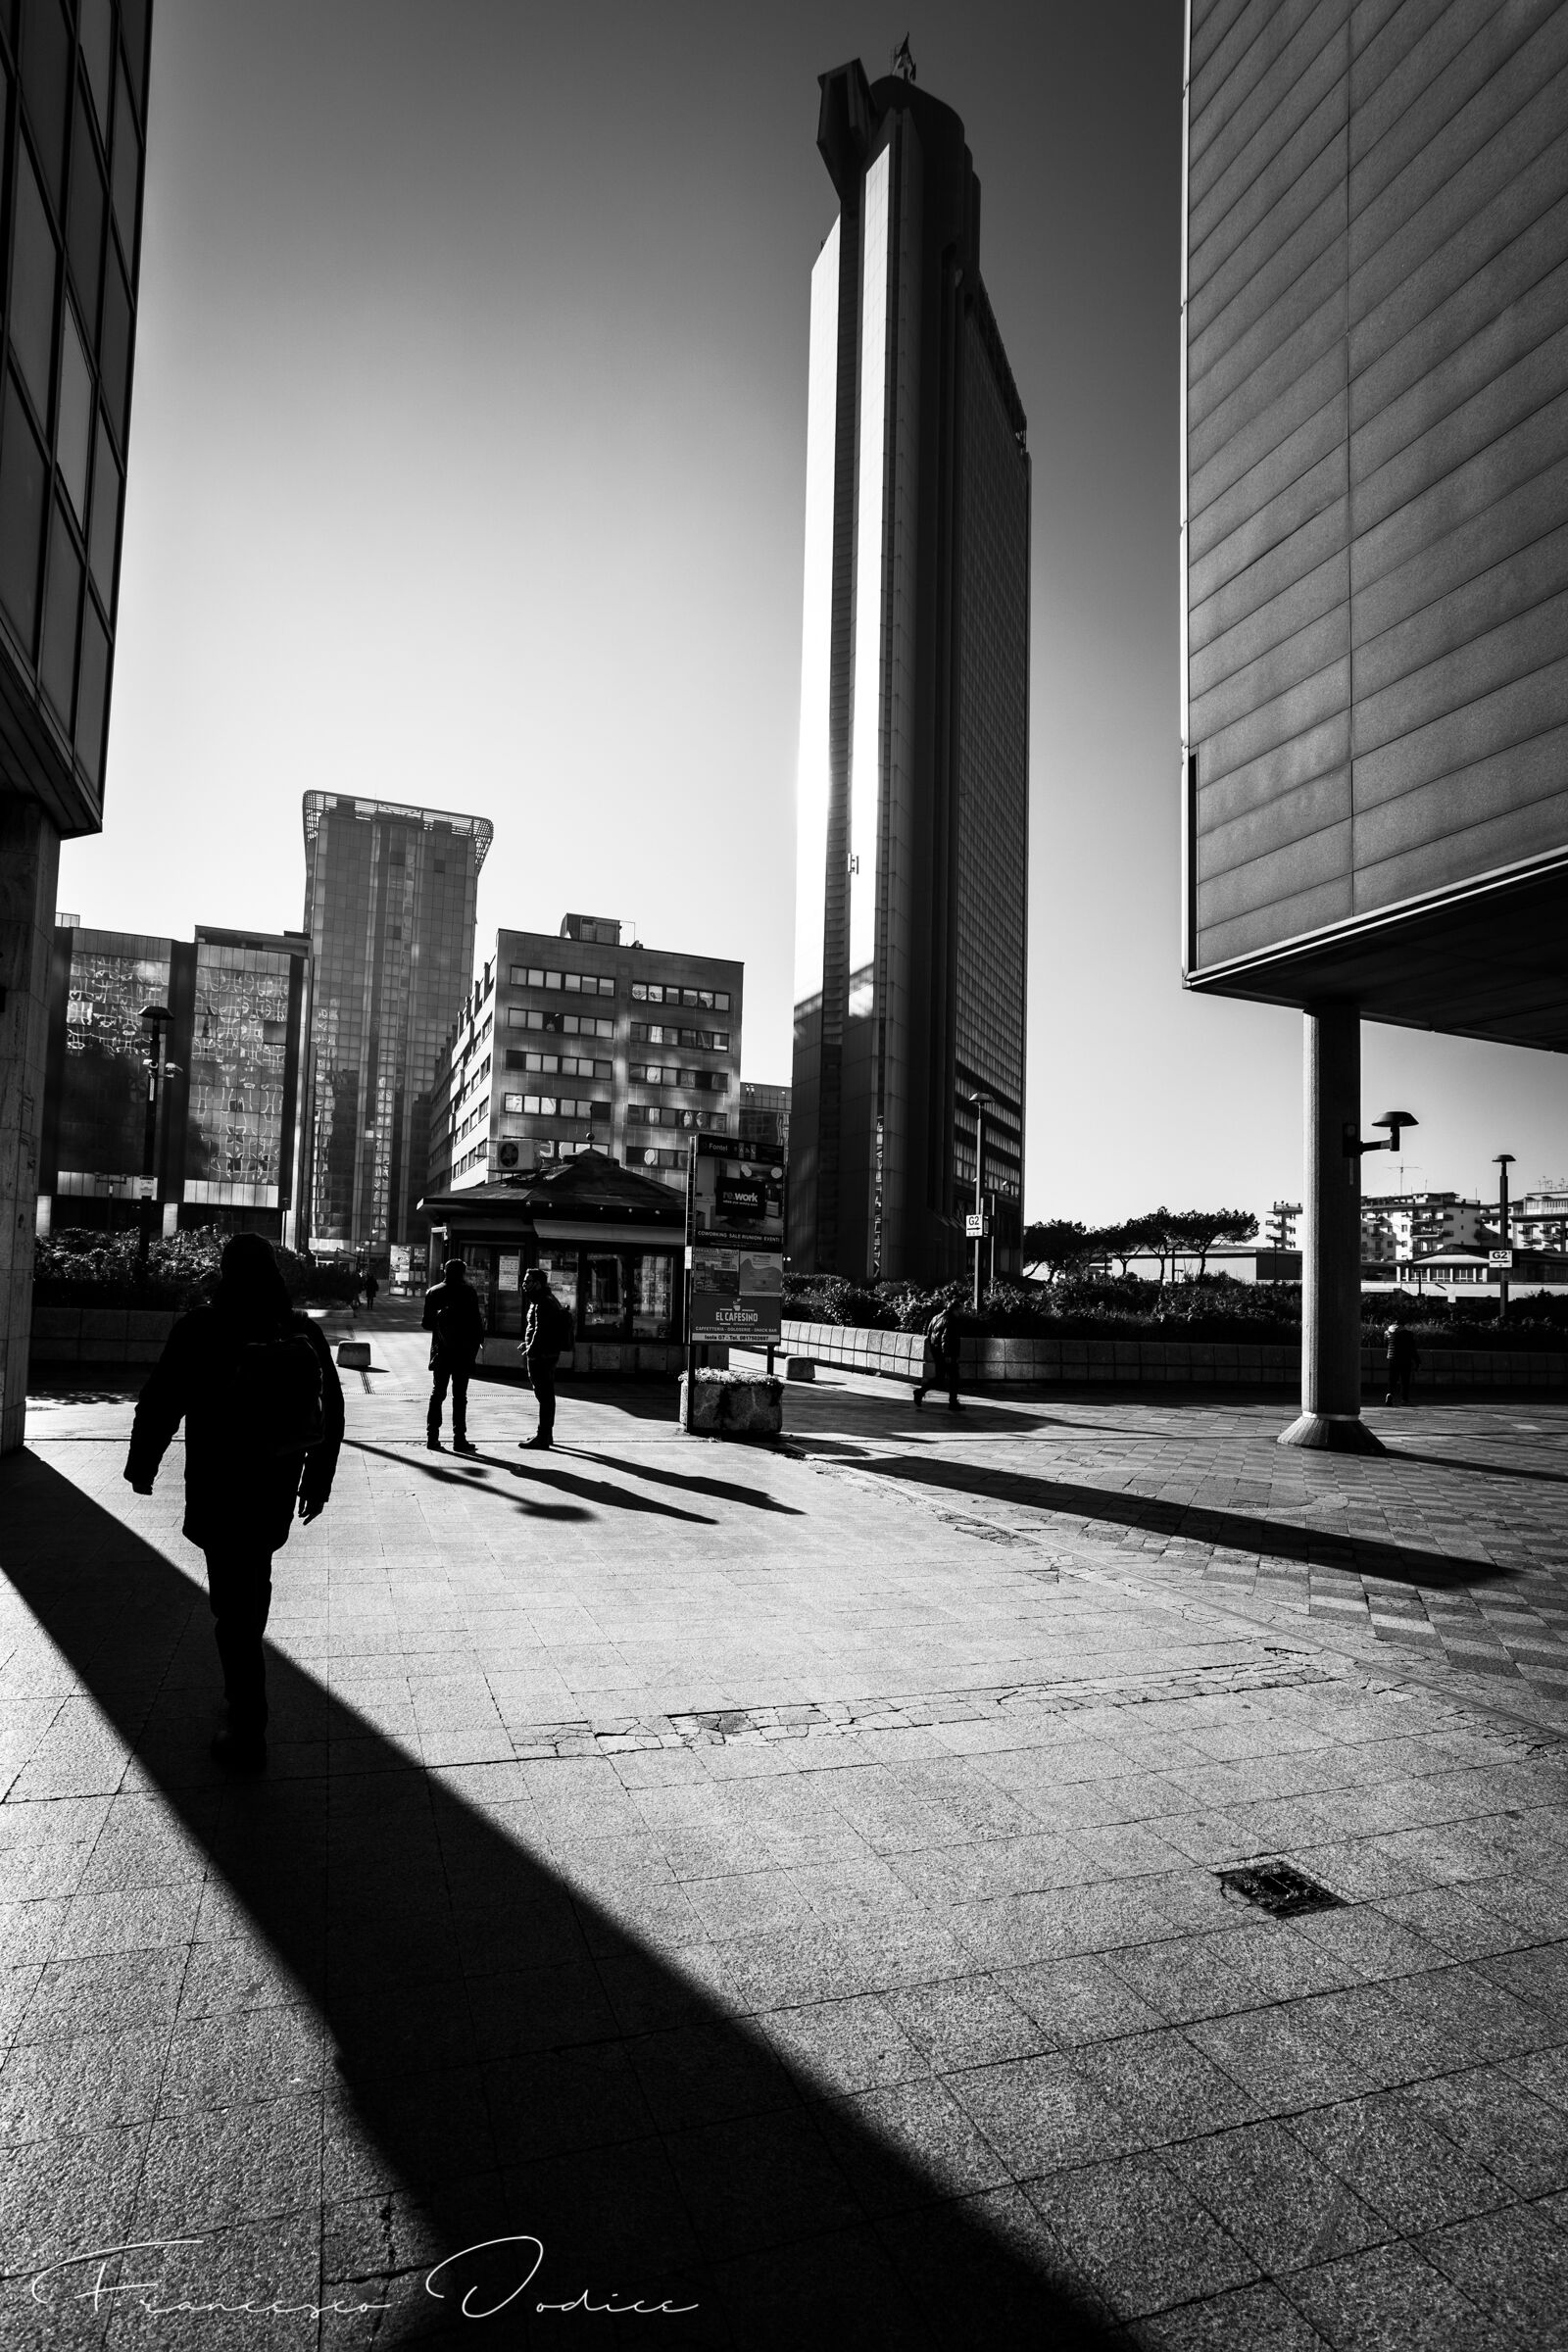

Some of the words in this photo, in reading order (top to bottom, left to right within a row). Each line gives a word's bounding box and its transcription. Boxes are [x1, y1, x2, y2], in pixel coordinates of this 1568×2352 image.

[968, 1216, 979, 1225] G2
[1493, 1250, 1508, 1259] G2
[715, 1312, 724, 1321] EL
[725, 1312, 759, 1322] CAFESINO
